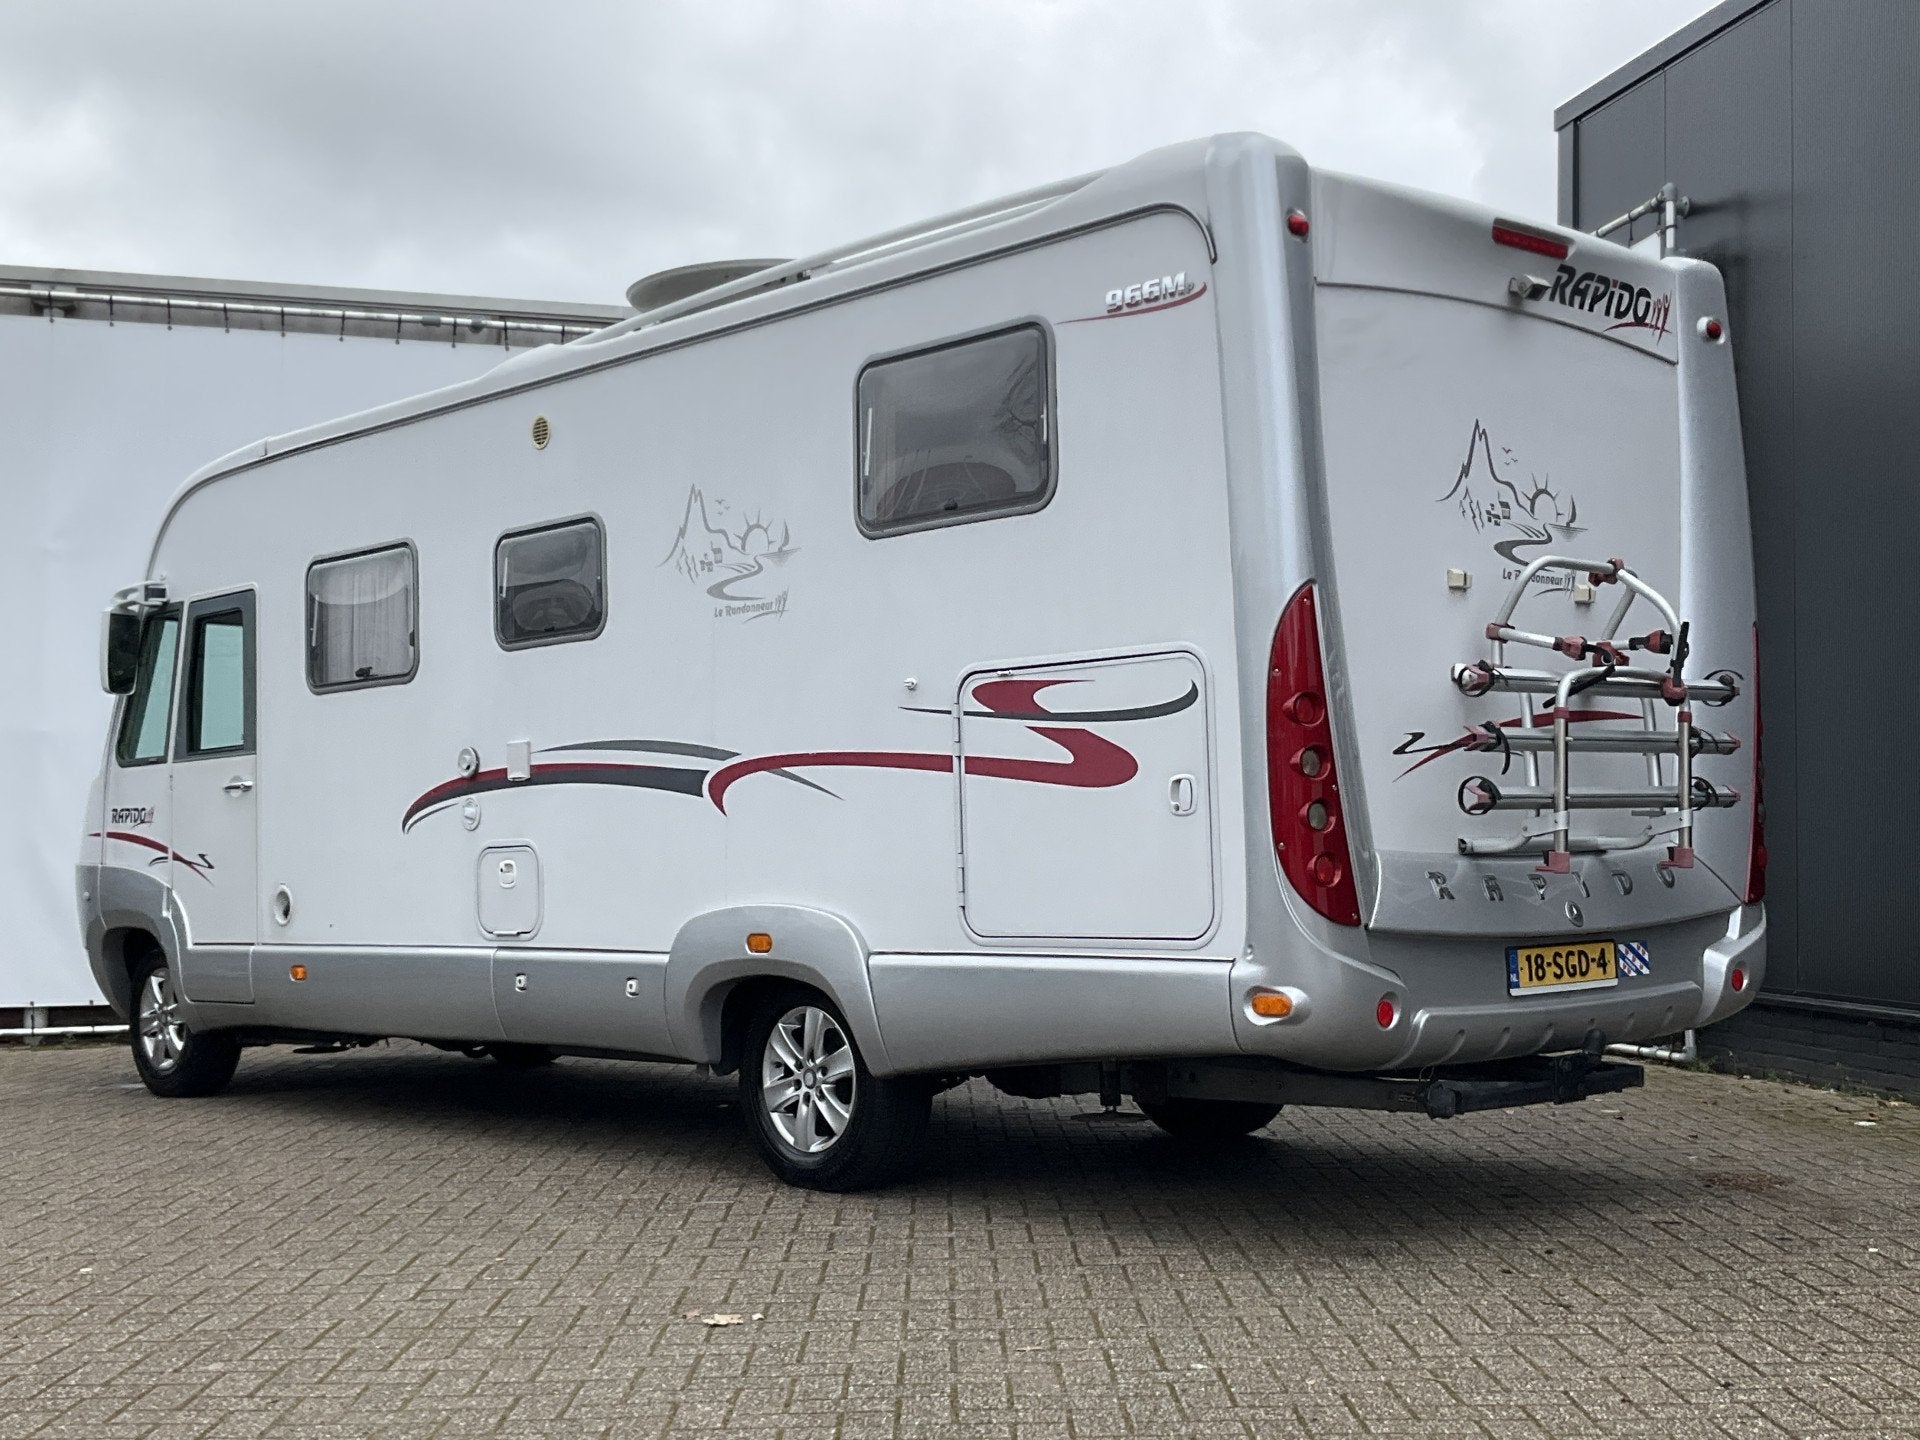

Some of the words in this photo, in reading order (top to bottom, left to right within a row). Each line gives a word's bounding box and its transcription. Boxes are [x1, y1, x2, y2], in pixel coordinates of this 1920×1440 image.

[1105, 271, 1186, 314] 966M
[1503, 567, 1512, 580] Le
[1514, 569, 1563, 586] Rdonneur
[714, 607, 723, 618] Le
[1425, 860, 1676, 901] RAPIDO
[1525, 947, 1608, 982] 18-SGD-4
